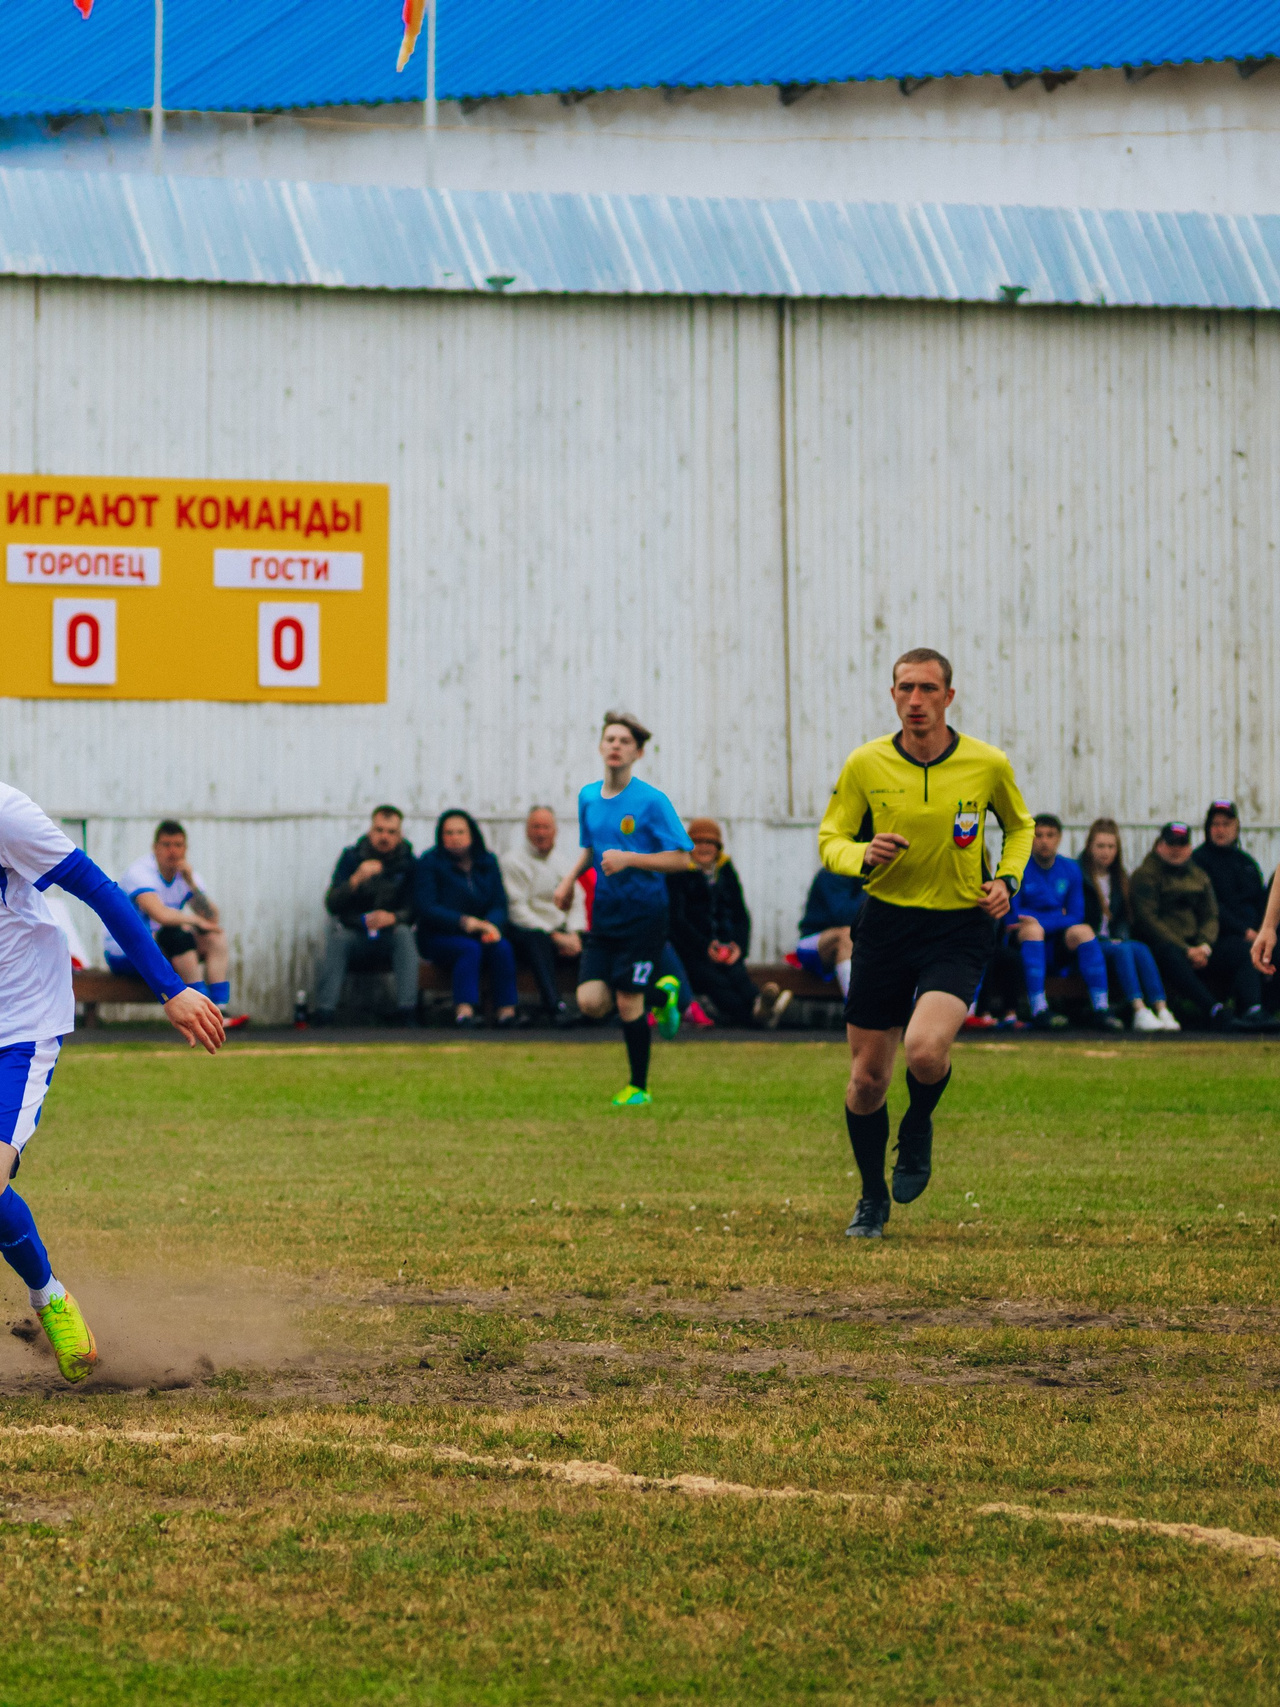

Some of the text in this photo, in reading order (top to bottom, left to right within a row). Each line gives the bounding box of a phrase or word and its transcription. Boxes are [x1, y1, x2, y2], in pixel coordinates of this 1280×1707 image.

[7, 491, 362, 538] ИГРАЮТ КОМАНДЫ
[24, 551, 146, 582] ТОРОПЕЦ
[250, 556, 330, 582] ГОСТИ
[67, 613, 100, 668] 0
[272, 617, 304, 671] 0
